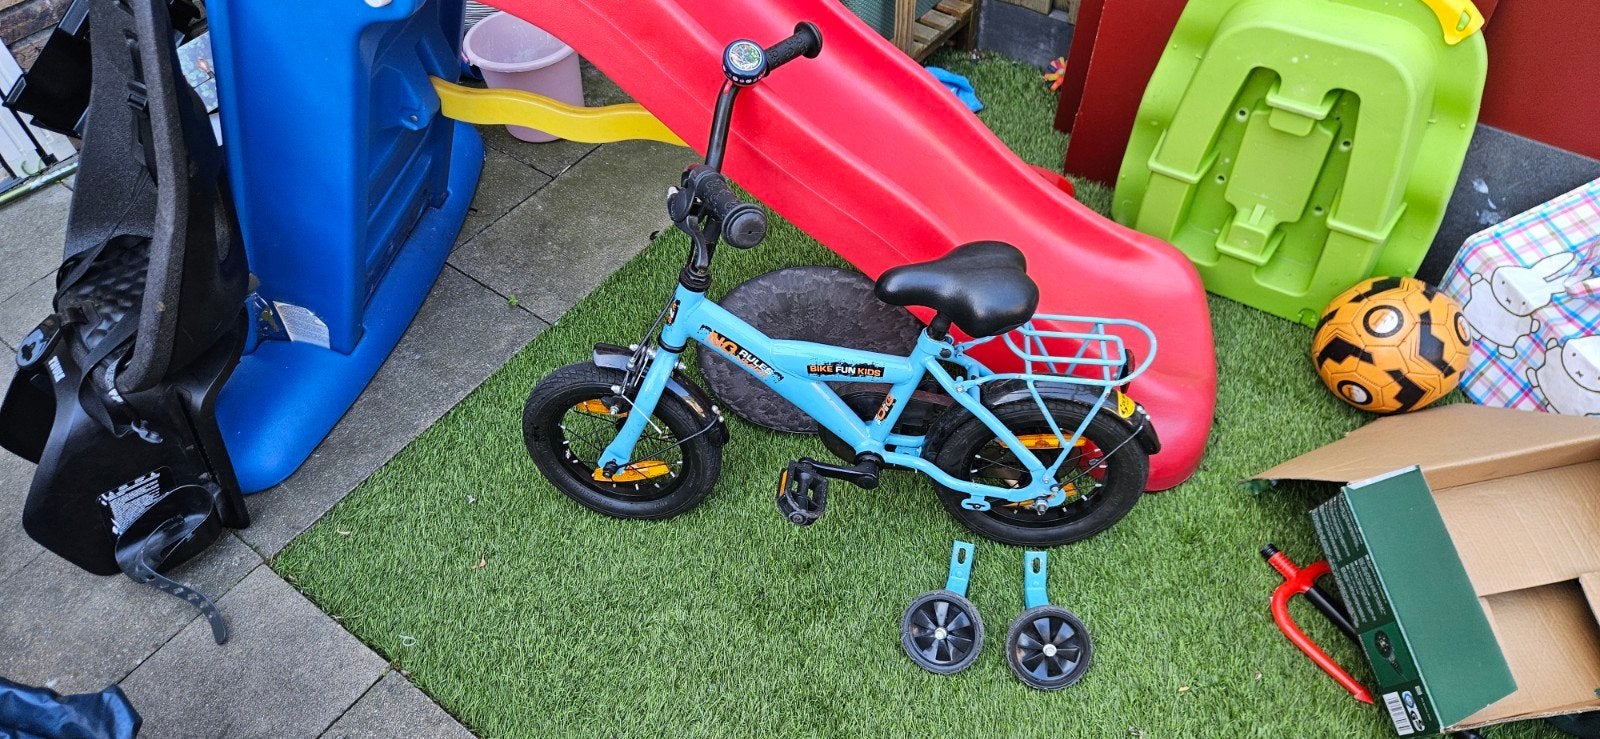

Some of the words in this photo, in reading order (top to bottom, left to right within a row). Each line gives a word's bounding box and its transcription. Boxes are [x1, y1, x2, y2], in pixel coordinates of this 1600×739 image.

[706, 331, 738, 355] NO
[739, 350, 773, 374] RULES
[809, 365, 833, 373] BIKE
[836, 366, 856, 374] FUN
[857, 368, 881, 377] KIDS
